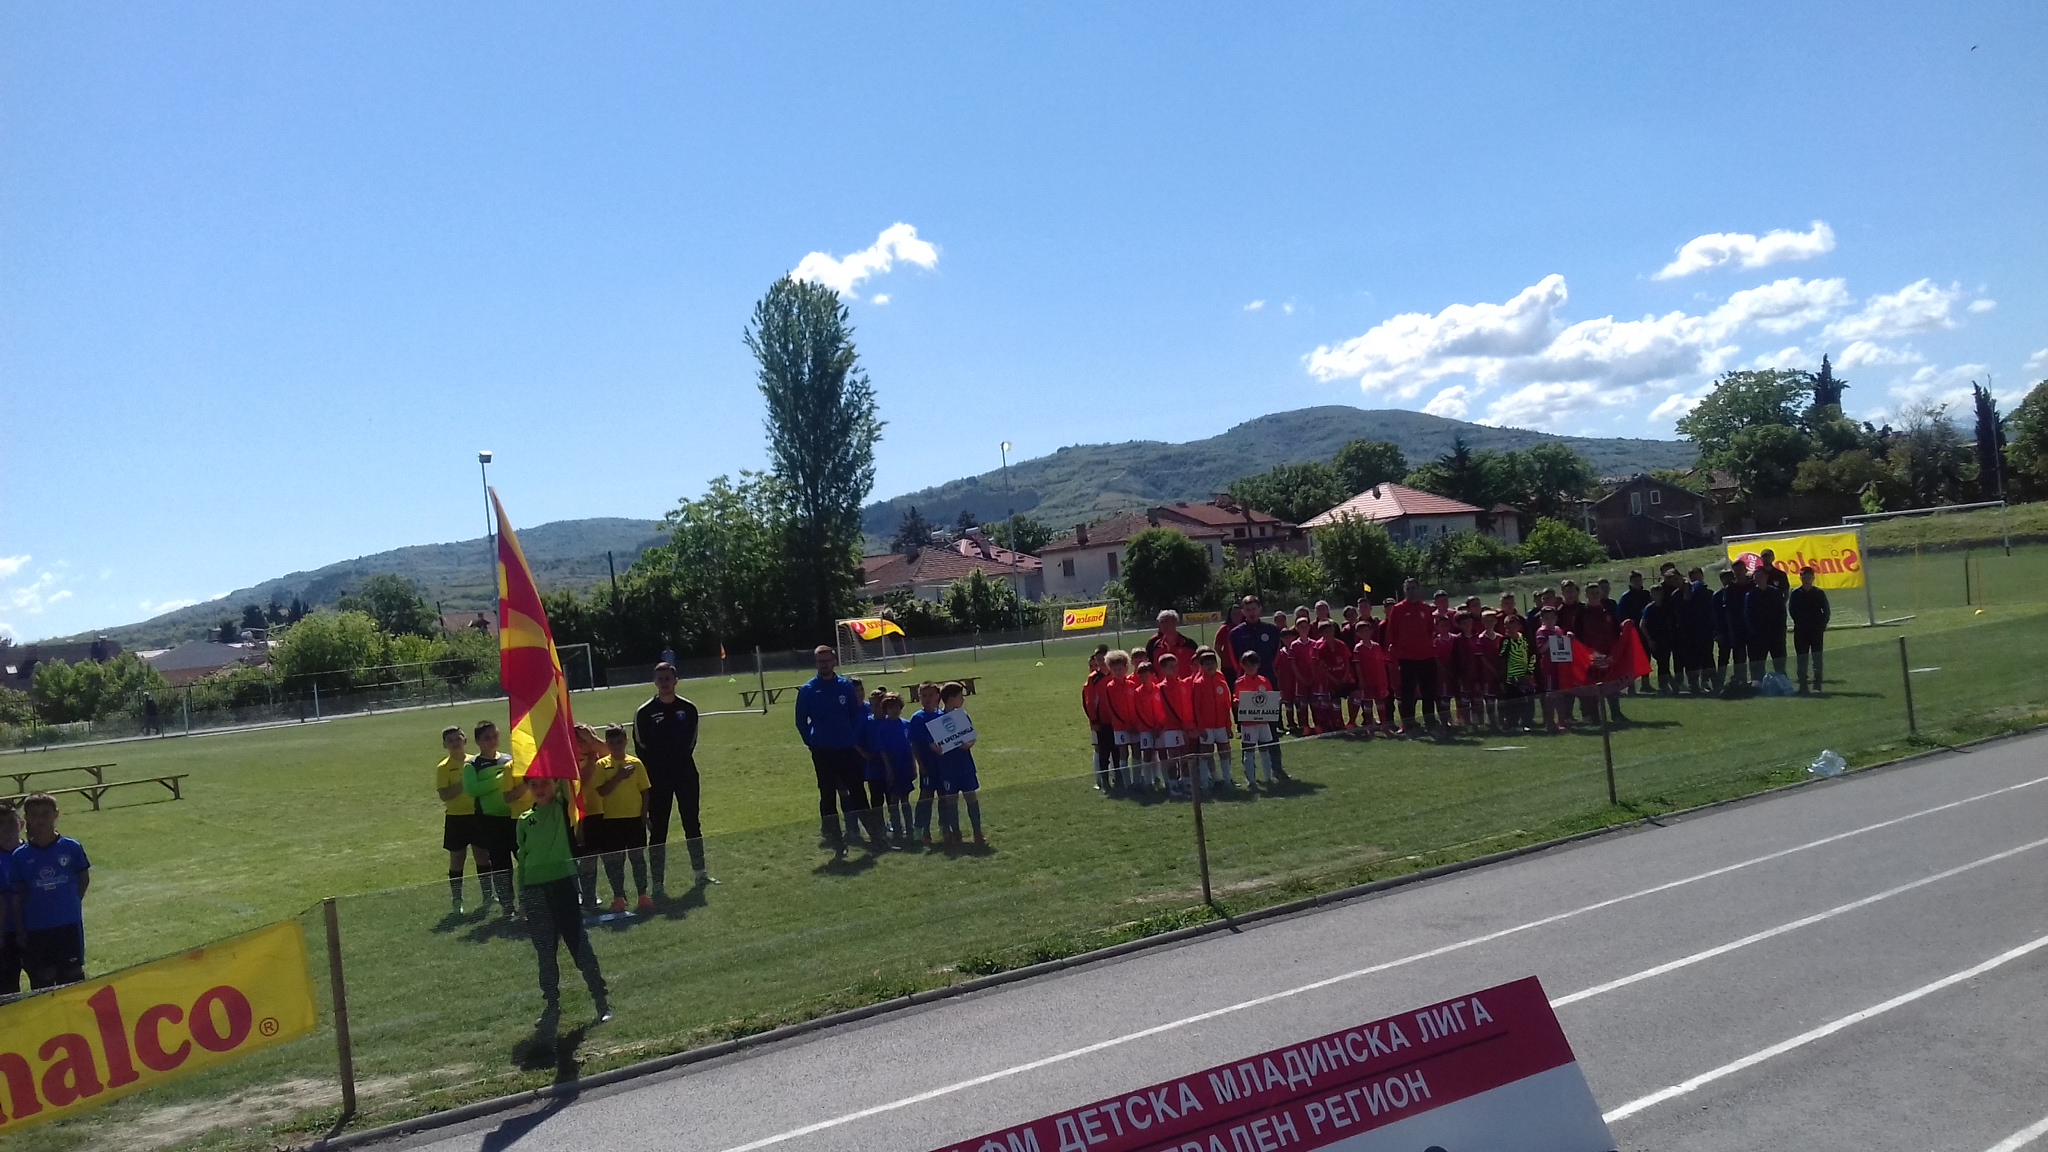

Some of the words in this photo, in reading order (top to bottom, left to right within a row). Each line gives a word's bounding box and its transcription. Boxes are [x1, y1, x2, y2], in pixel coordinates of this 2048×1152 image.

[1055, 1081, 1204, 1152] ДЕТСКА
[1208, 1021, 1411, 1104] МЛАДИНСКА
[1415, 997, 1494, 1043] ЛИГА
[1160, 1110, 1300, 1152] АЛЕН
[1305, 1069, 1431, 1135] РЕГИОН
